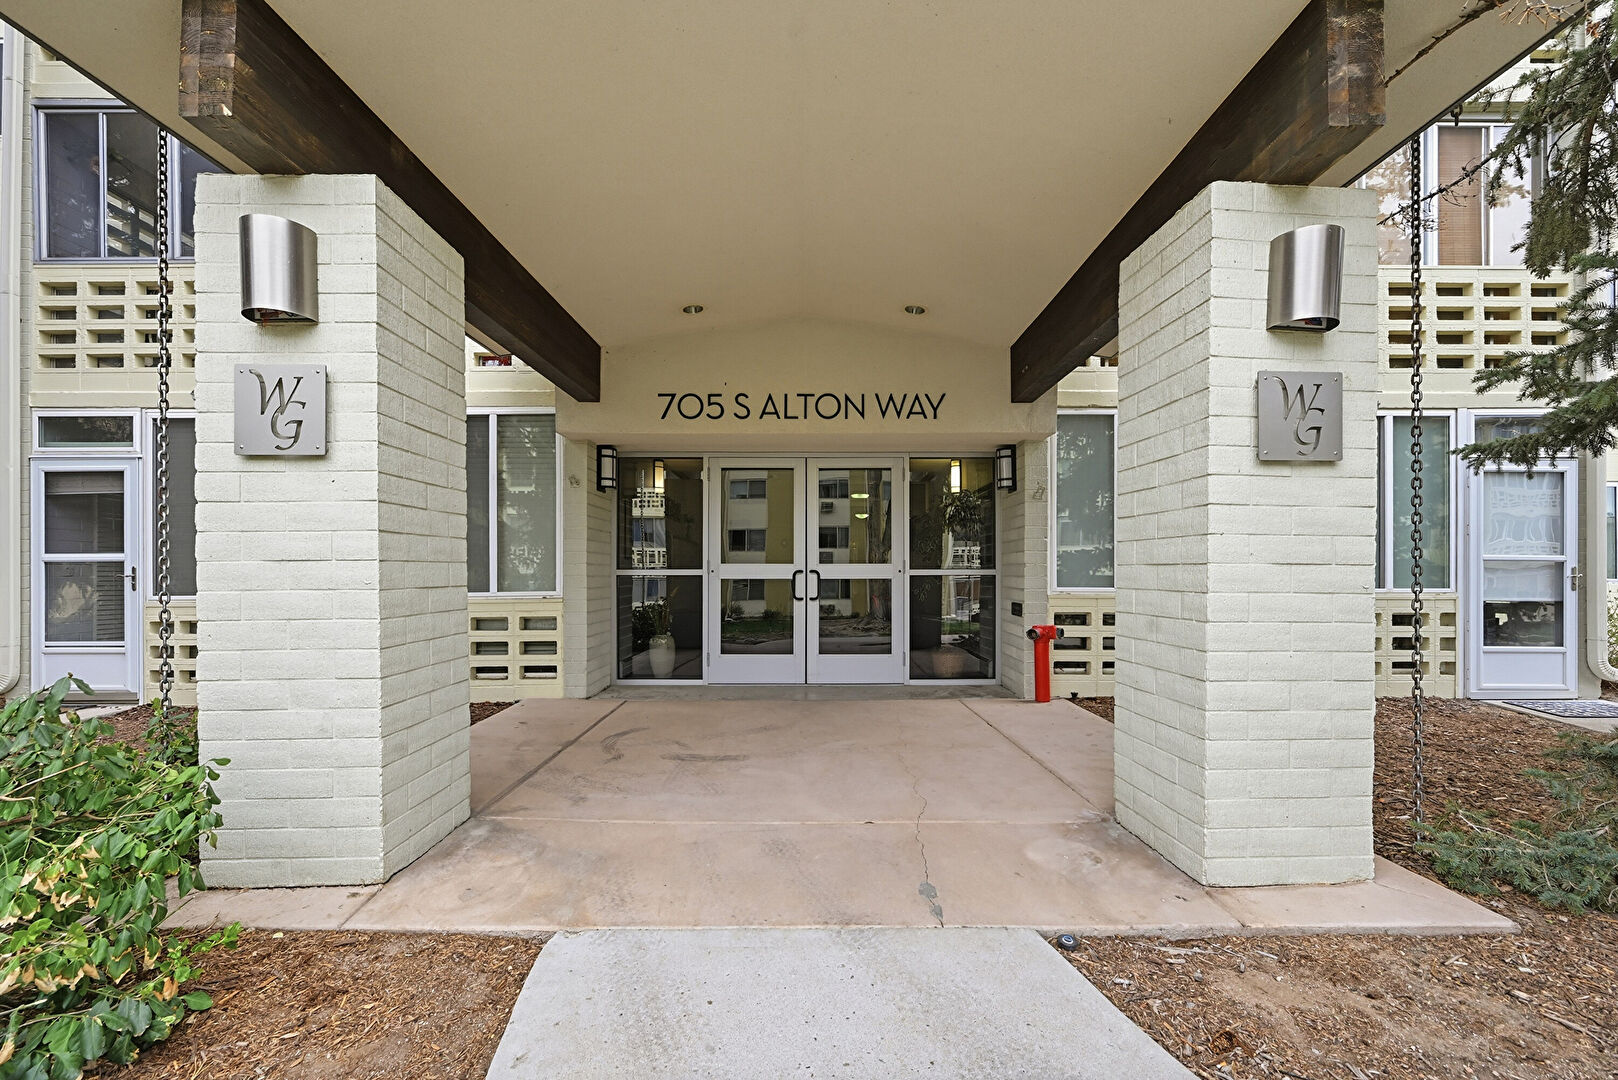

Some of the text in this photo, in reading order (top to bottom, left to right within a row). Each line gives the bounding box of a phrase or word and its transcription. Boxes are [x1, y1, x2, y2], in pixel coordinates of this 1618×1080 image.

[657, 392, 946, 420] 705 S ALTON WAY
